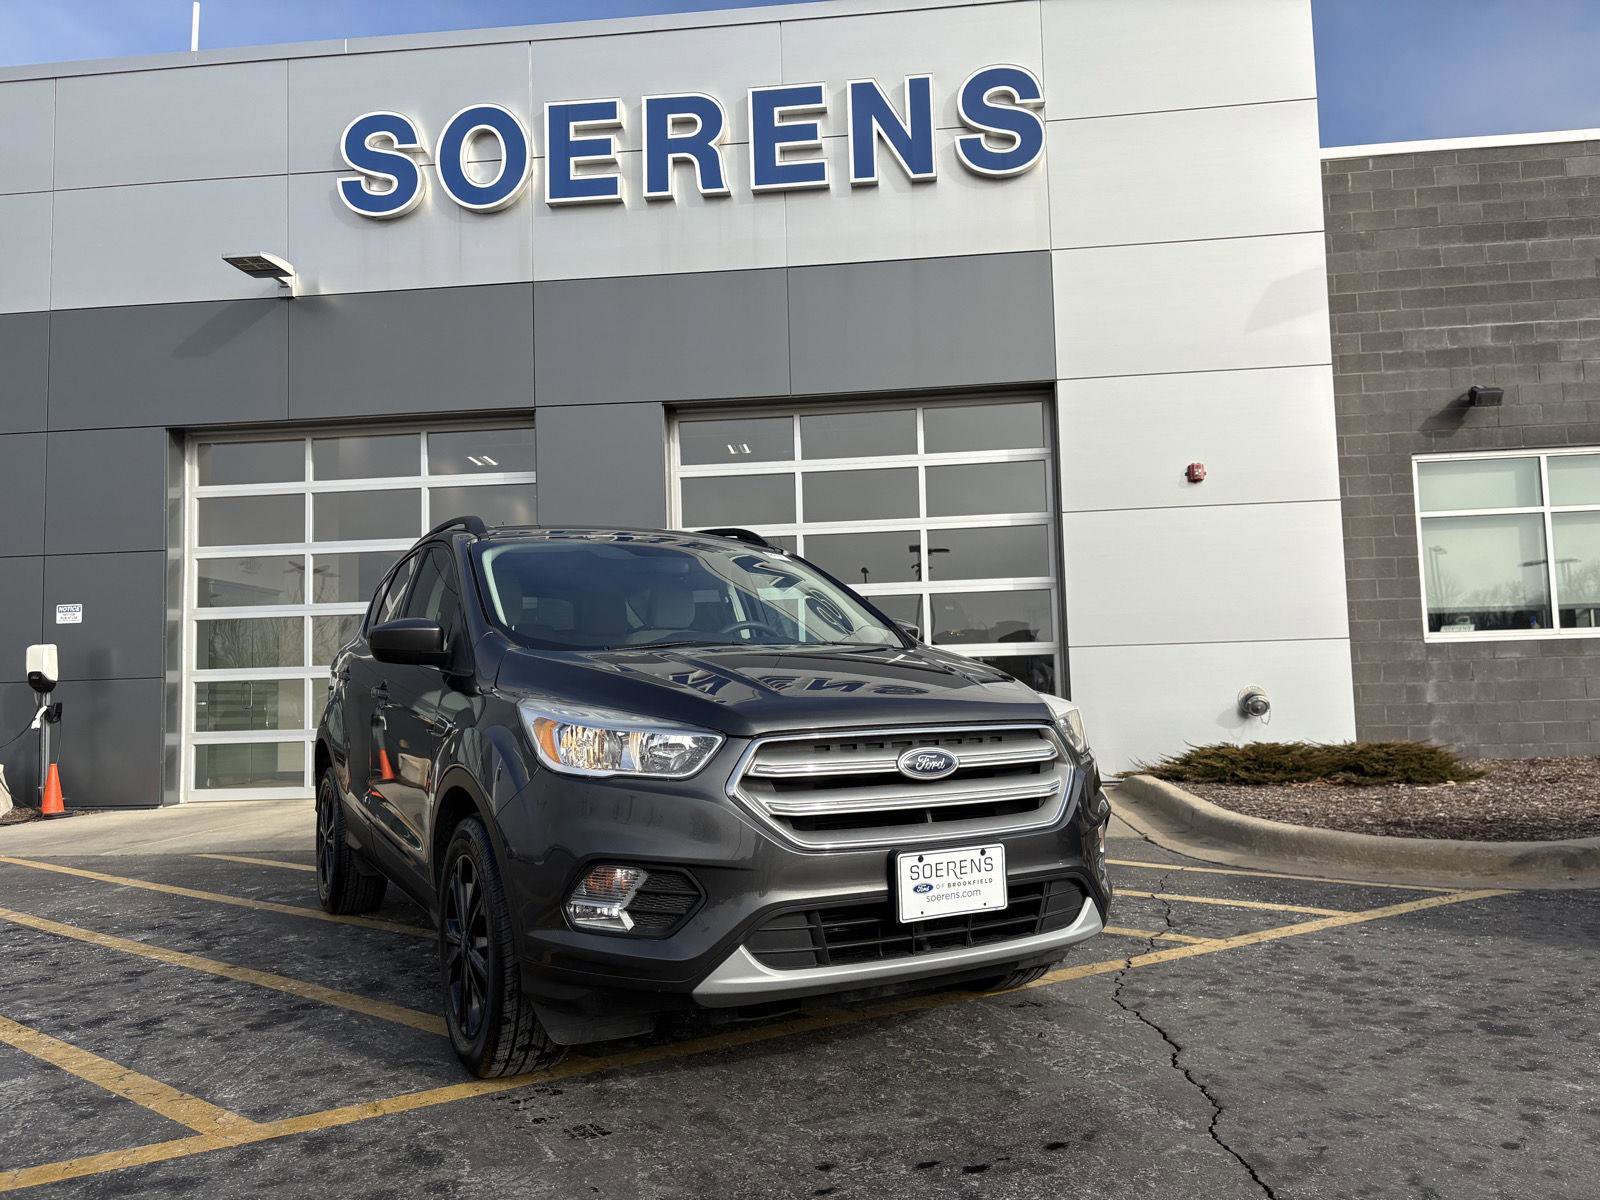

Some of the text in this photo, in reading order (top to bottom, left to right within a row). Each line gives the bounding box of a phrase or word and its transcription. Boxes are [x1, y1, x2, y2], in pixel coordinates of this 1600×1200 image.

[337, 64, 1046, 219] SOERENS
[915, 754, 946, 771] Ford
[910, 857, 994, 880] SOERENS
[947, 878, 993, 889] BROOKFIELD
[926, 889, 982, 903] soerens.com
